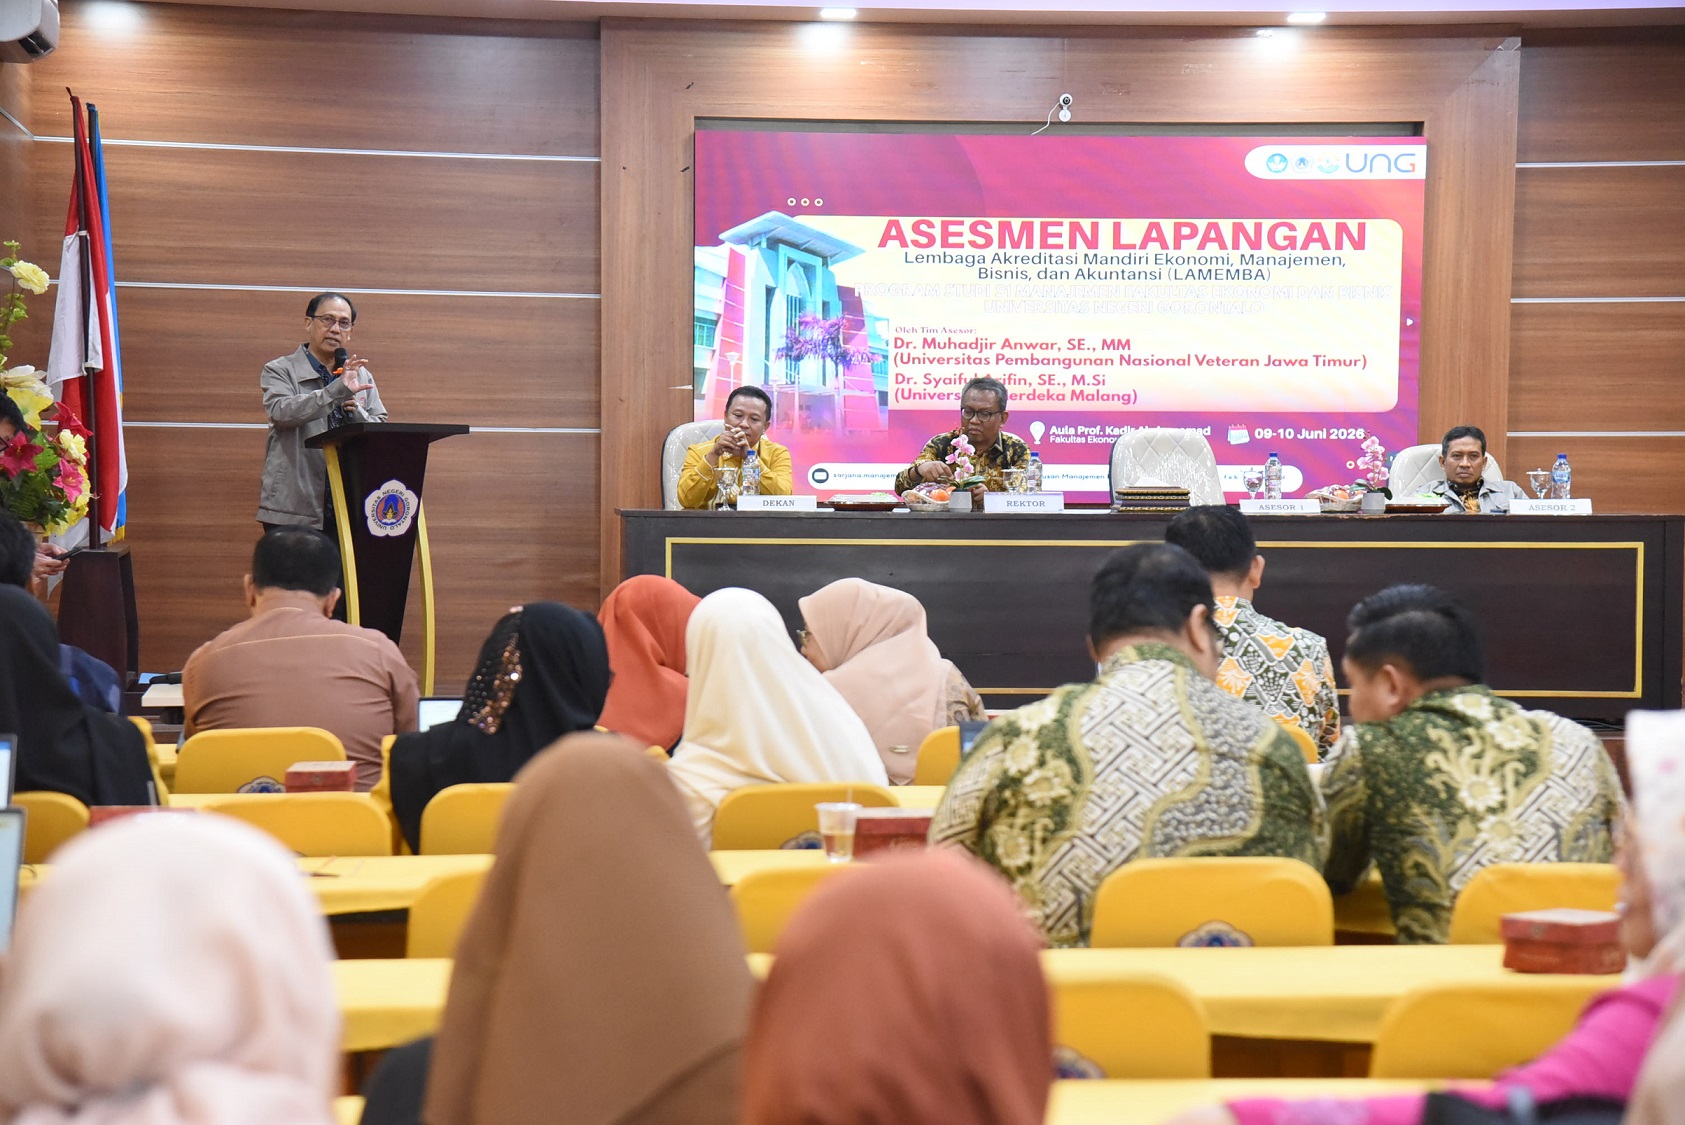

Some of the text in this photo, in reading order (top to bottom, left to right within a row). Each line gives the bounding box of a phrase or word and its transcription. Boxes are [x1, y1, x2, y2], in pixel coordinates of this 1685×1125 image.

[877, 219, 1367, 251] ASESMEN LAPANGAN
[904, 251, 1346, 268] Lembaga Akreditasi Mandiri Ekonomi, Manajemen,
[978, 267, 1271, 282] Bisnis, dan Akuntansi (LAMEMBA)
[854, 283, 941, 298] PROGRAM
[944, 284, 991, 298] STUDI
[1015, 284, 1121, 299] MANAJEMEN
[1124, 285, 1207, 299] FAKULTAS
[1212, 285, 1293, 299] EKONOMI
[1297, 286, 1334, 300] DAN
[1339, 286, 1392, 300] BISNIS
[983, 300, 1266, 315] UNIVERSITAS NEGERI GORONTALO
[895, 326, 977, 335] Oleh Tim Asesor:
[893, 337, 1131, 353] Dr. Muhadjir Anwar, SE., MM
[893, 352, 1367, 370] (Universitas Pembangunan Nasional Veteran Jawa Timur)
[894, 373, 917, 386] Dr.
[1037, 374, 1066, 388] SE.,
[1071, 374, 1106, 387] M.Si
[1006, 389, 1066, 402] erdeka
[1070, 389, 1138, 405] Malang)
[1049, 426, 1074, 436] Aula
[1078, 426, 1103, 436] Prof.
[1254, 428, 1365, 440] 09-10 Juni 2026
[1050, 435, 1086, 444] Fakultas
[1061, 473, 1105, 481] Manajemen
[382, 489, 405, 497] NEGERI
[762, 499, 795, 508] DEKAN
